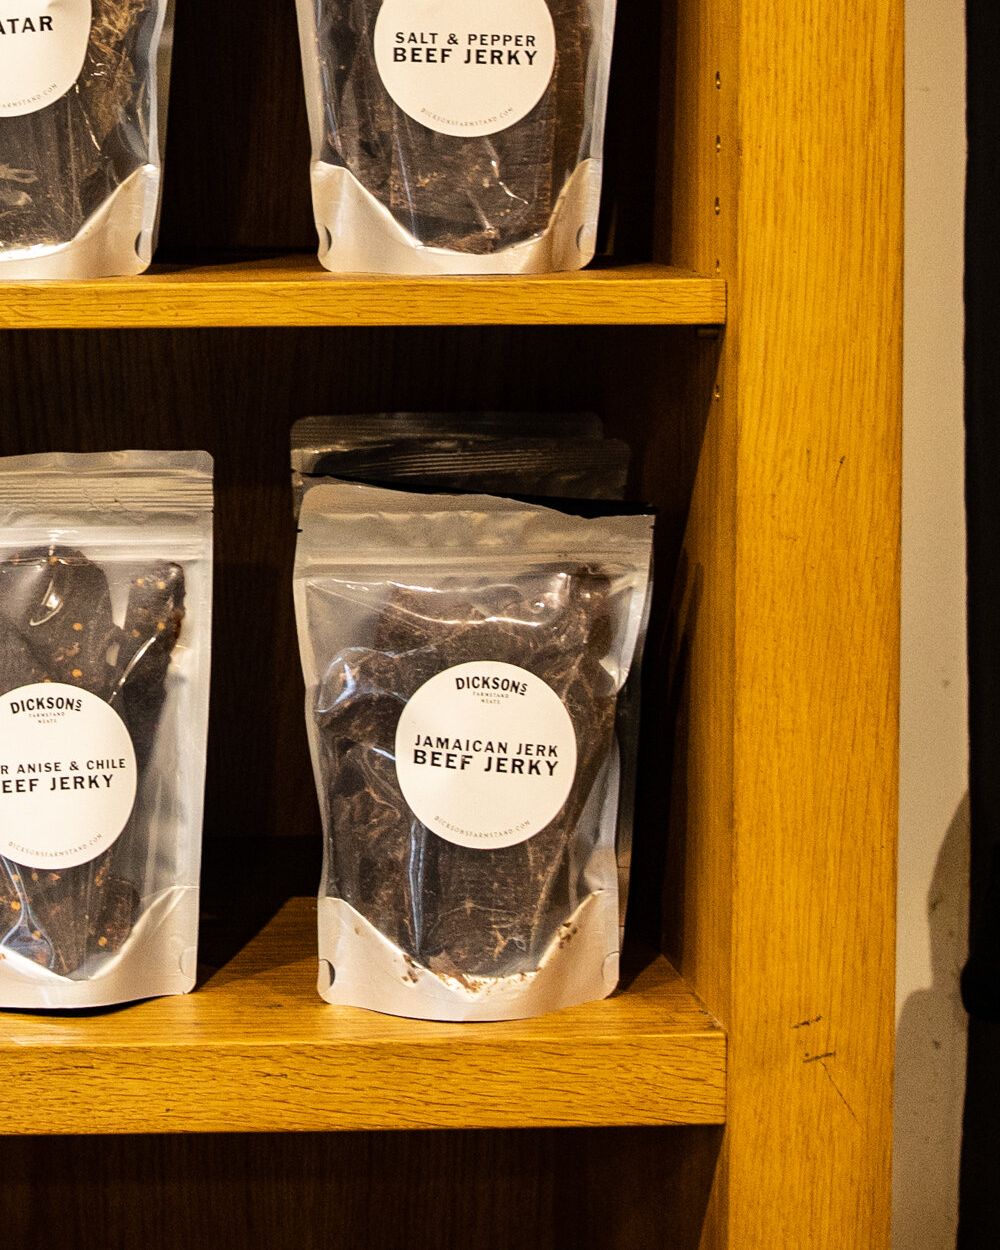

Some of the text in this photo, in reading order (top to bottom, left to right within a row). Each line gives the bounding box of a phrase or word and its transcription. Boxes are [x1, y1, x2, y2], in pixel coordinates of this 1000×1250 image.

[395, 32, 536, 47] SALT & PEPPER
[393, 47, 538, 66] BEEF JERKY
[414, 734, 558, 757] JAMAICAN JERK
[17, 762, 62, 774] ANISE
[69, 760, 80, 771] &
[86, 758, 126, 770] CHILE
[413, 749, 559, 776] BEEF JERKY
[49, 773, 114, 791] JERKY
